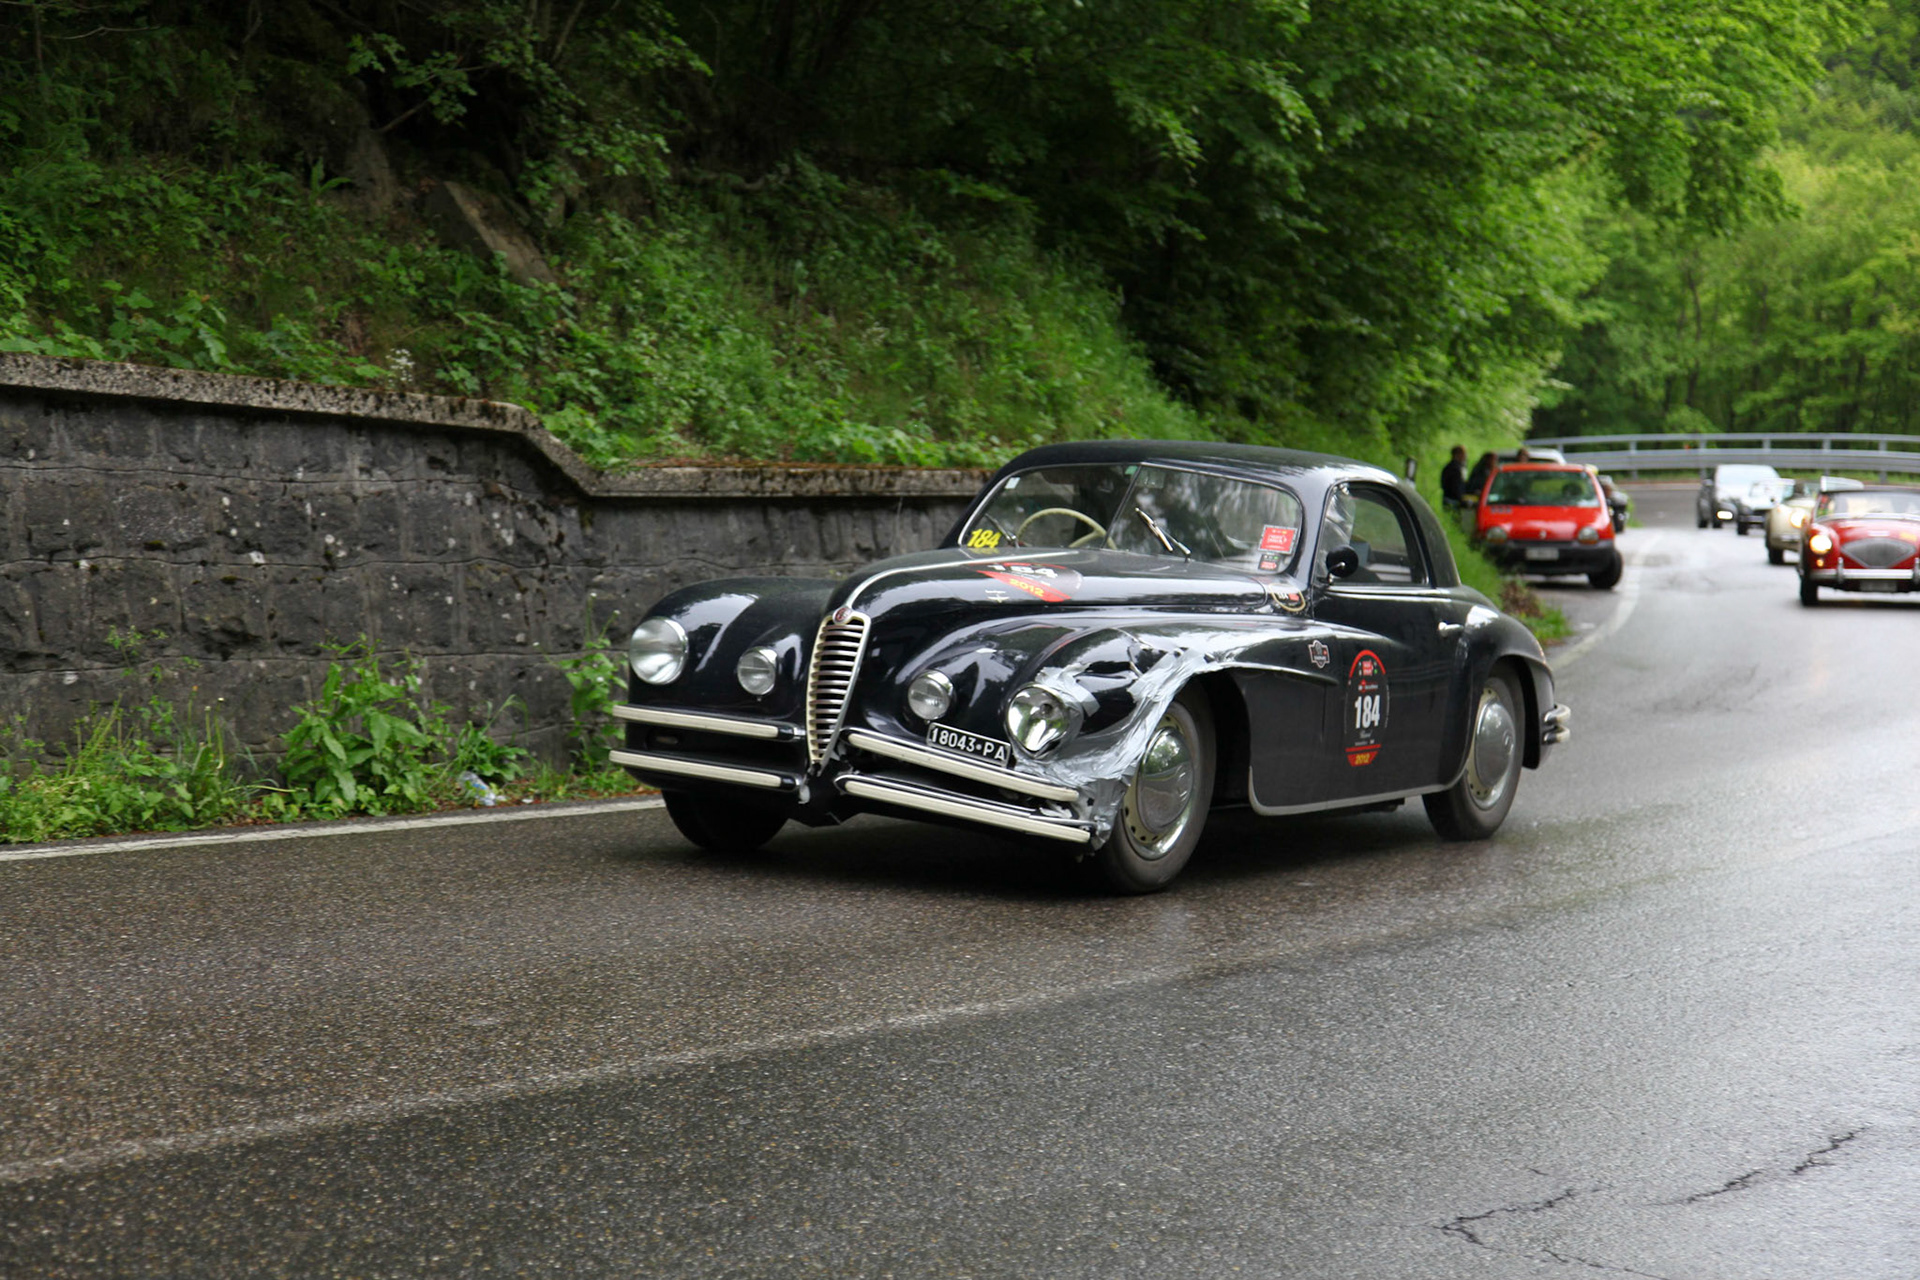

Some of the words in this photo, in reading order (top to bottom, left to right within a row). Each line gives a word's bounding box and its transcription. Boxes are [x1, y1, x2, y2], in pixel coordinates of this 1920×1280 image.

[967, 528, 1002, 549] 184
[1009, 578, 1045, 597] 2012
[1354, 694, 1381, 729] 184
